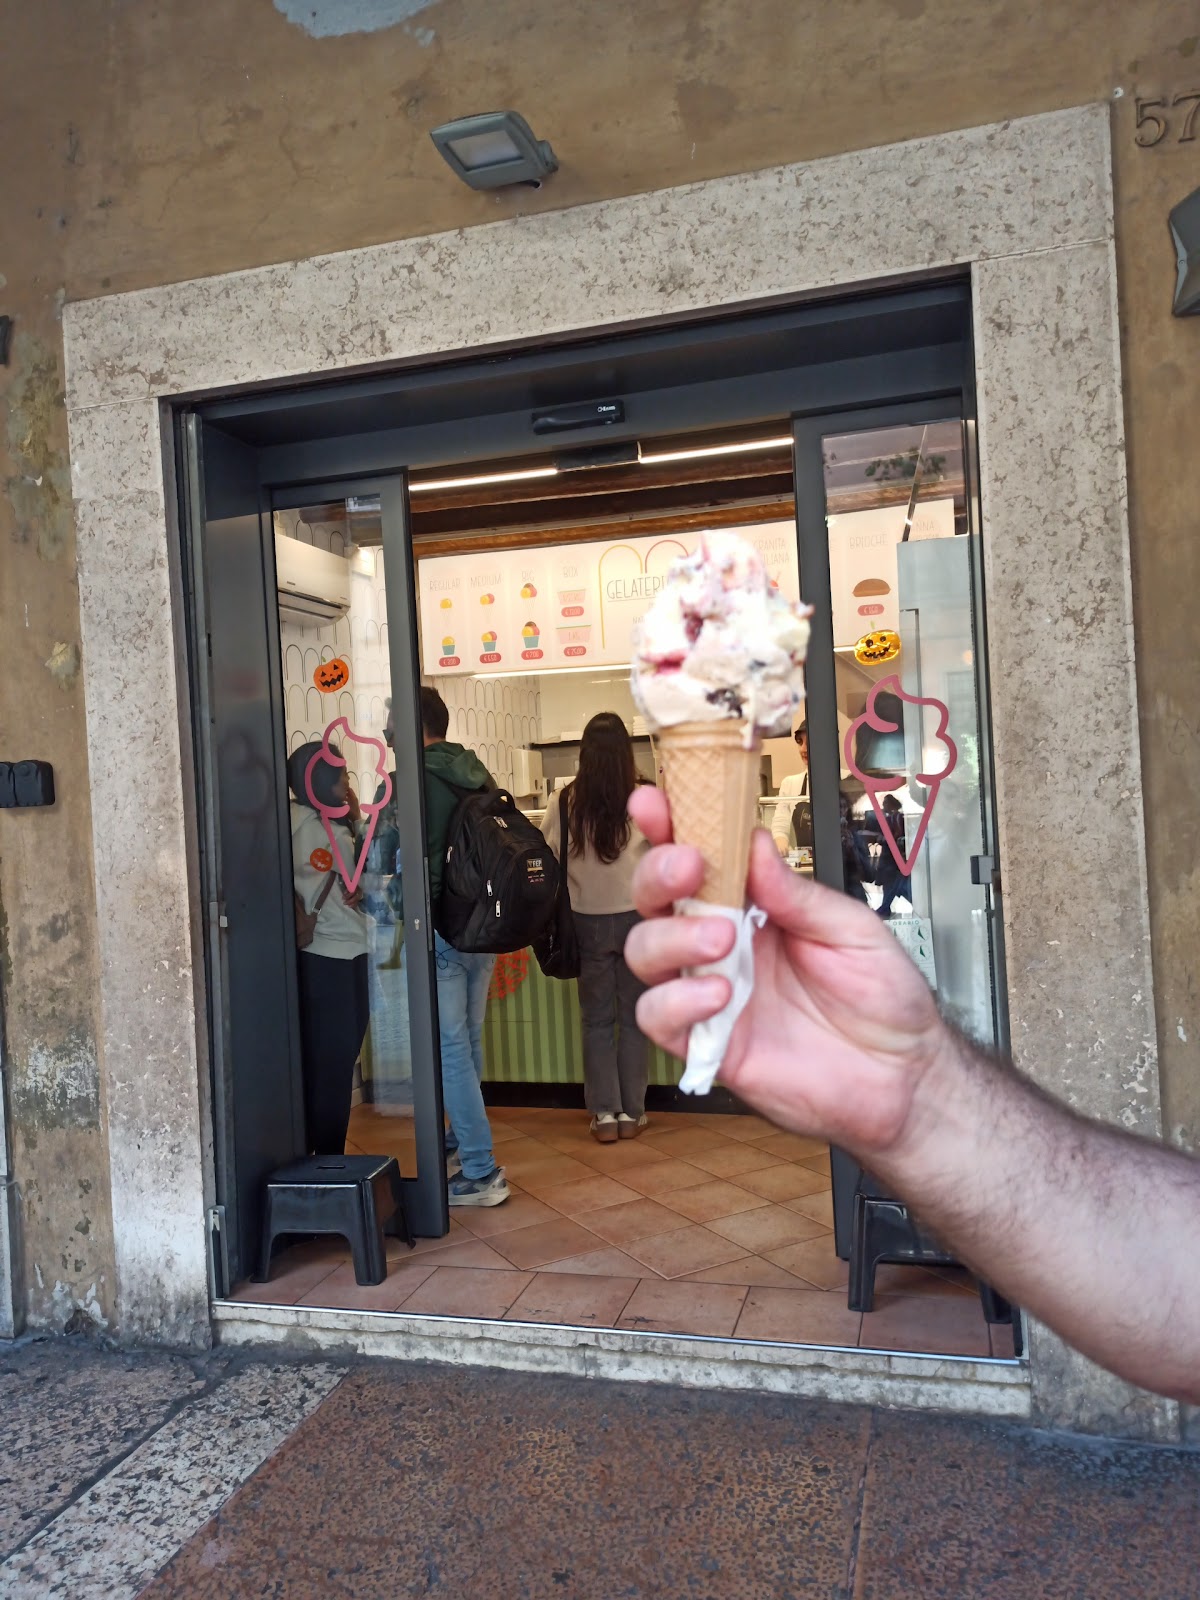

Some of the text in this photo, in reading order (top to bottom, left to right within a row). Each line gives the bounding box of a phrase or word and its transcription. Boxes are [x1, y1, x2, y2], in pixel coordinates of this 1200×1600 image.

[1134, 94, 1200, 148] 57
[849, 534, 888, 549] BRIOCHE
[521, 570, 535, 583] BIG
[562, 566, 579, 579] BOX
[429, 577, 461, 592] REGULAR
[470, 574, 502, 588] MEDIUM
[606, 575, 669, 600] GELATERI
